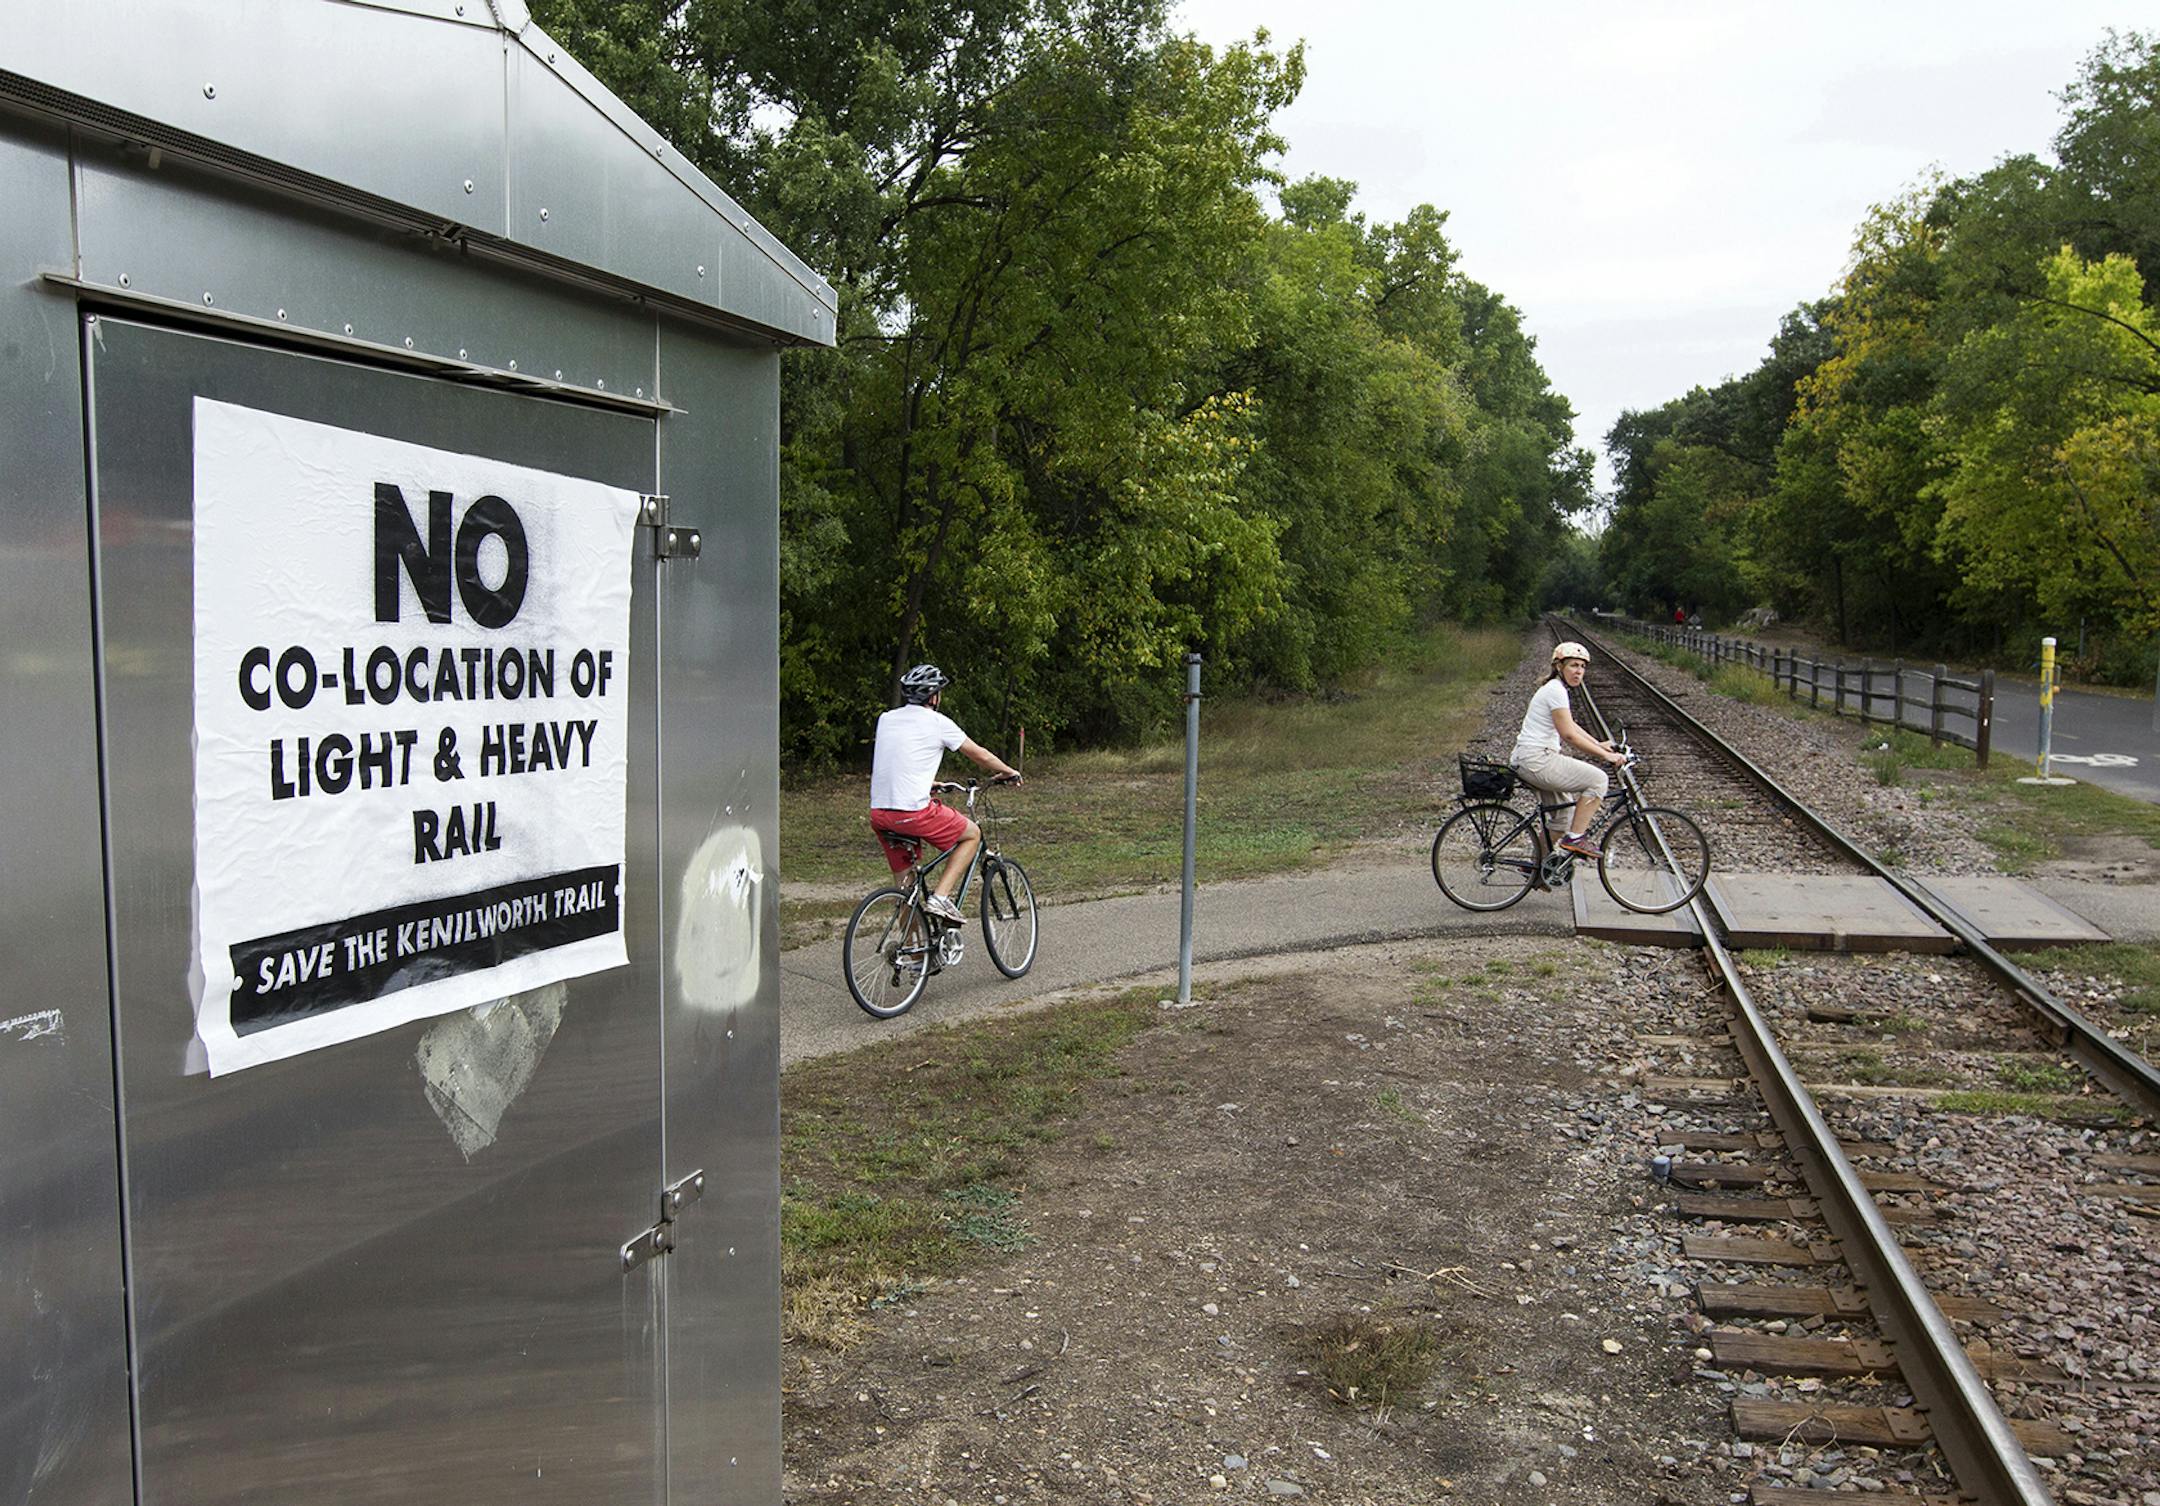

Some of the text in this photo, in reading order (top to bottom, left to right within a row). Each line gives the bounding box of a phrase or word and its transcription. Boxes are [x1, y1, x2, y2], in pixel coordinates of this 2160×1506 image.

[375, 482, 529, 629] NO
[239, 646, 613, 710] CO-LOCATION OF
[271, 720, 598, 800] LIGHT & HEAVY
[413, 802, 502, 864] RAIL
[256, 880, 606, 995] SAVE THE KENILWORTH TRAIL
